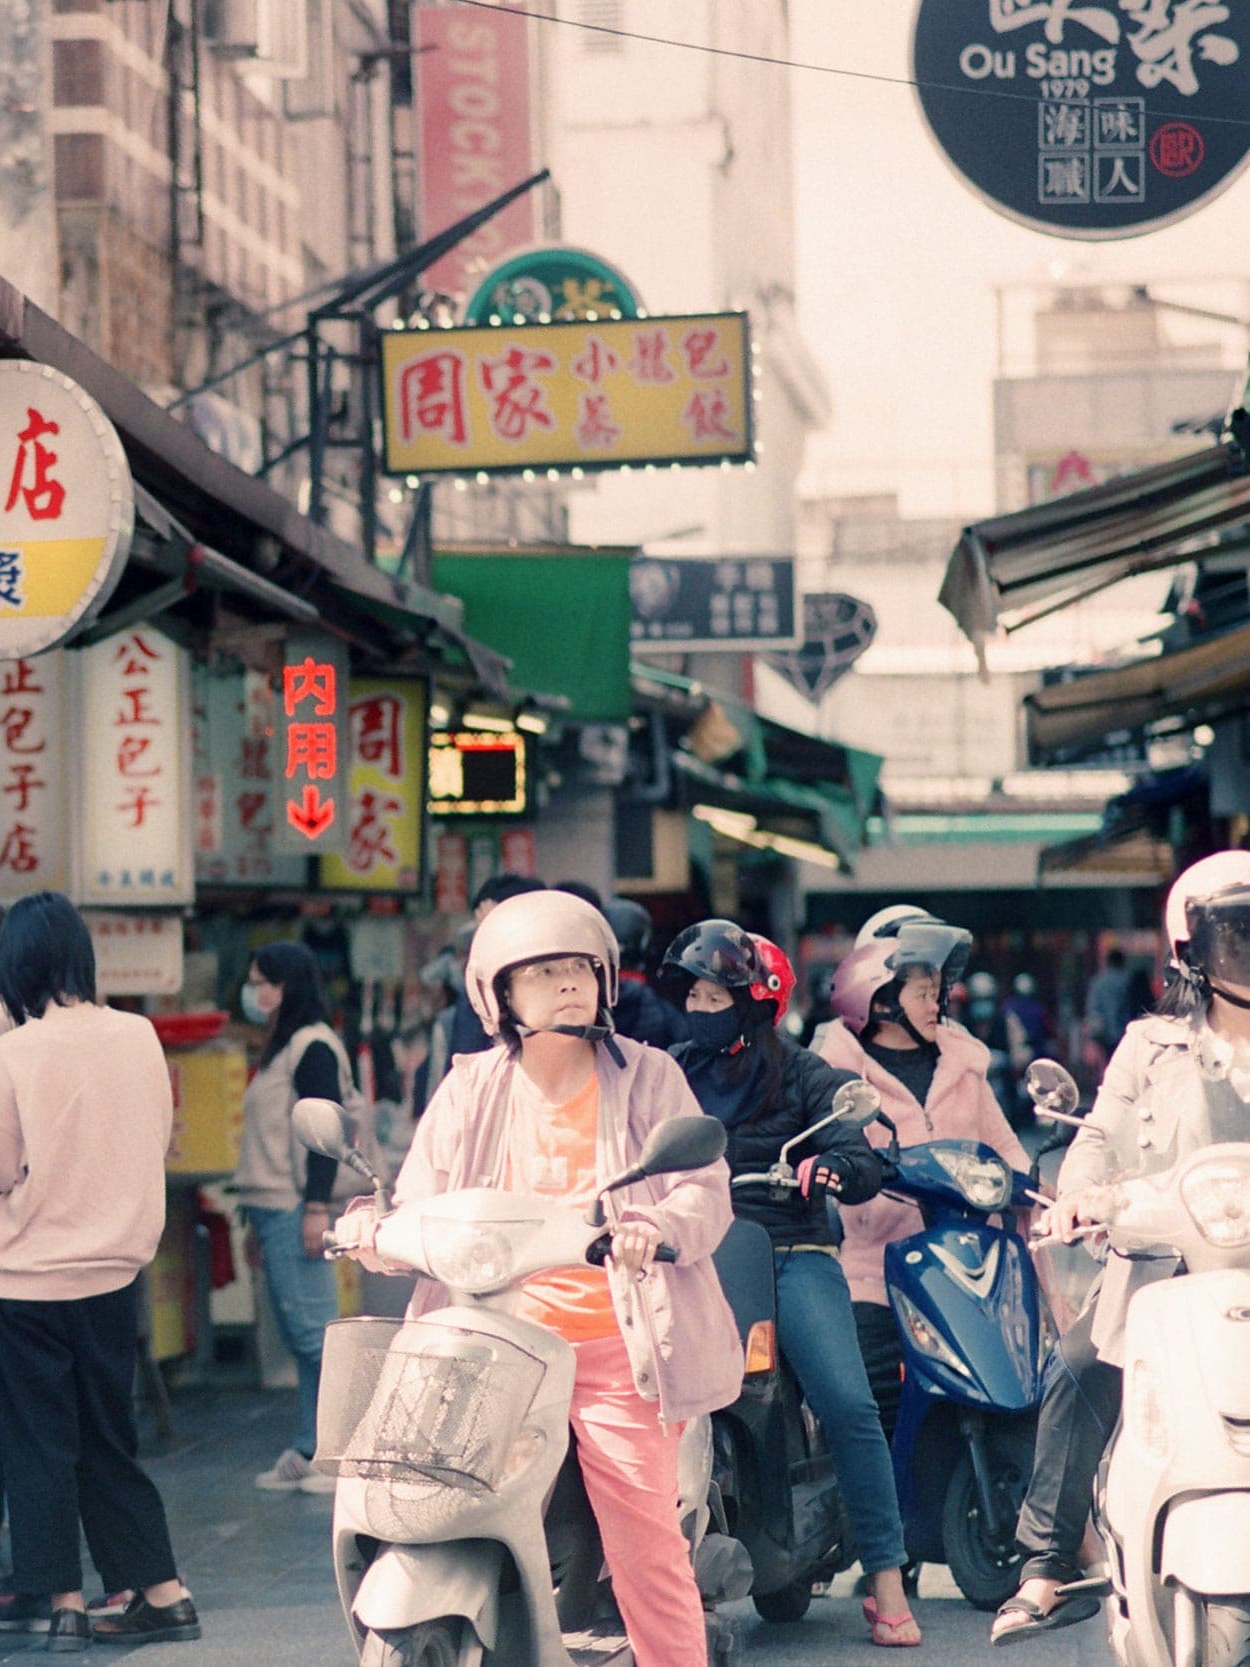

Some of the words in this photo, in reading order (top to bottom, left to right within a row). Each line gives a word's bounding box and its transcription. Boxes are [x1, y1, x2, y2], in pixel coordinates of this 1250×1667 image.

[959, 43, 1015, 79] Ou
[1026, 43, 1118, 85] Sang
[1040, 78, 1090, 99] 1979
[1044, 103, 1139, 145] 海味
[401, 347, 554, 444] 周家
[114, 633, 161, 828] 公正包子
[283, 656, 338, 779] 內用
[349, 696, 402, 871] 周家
